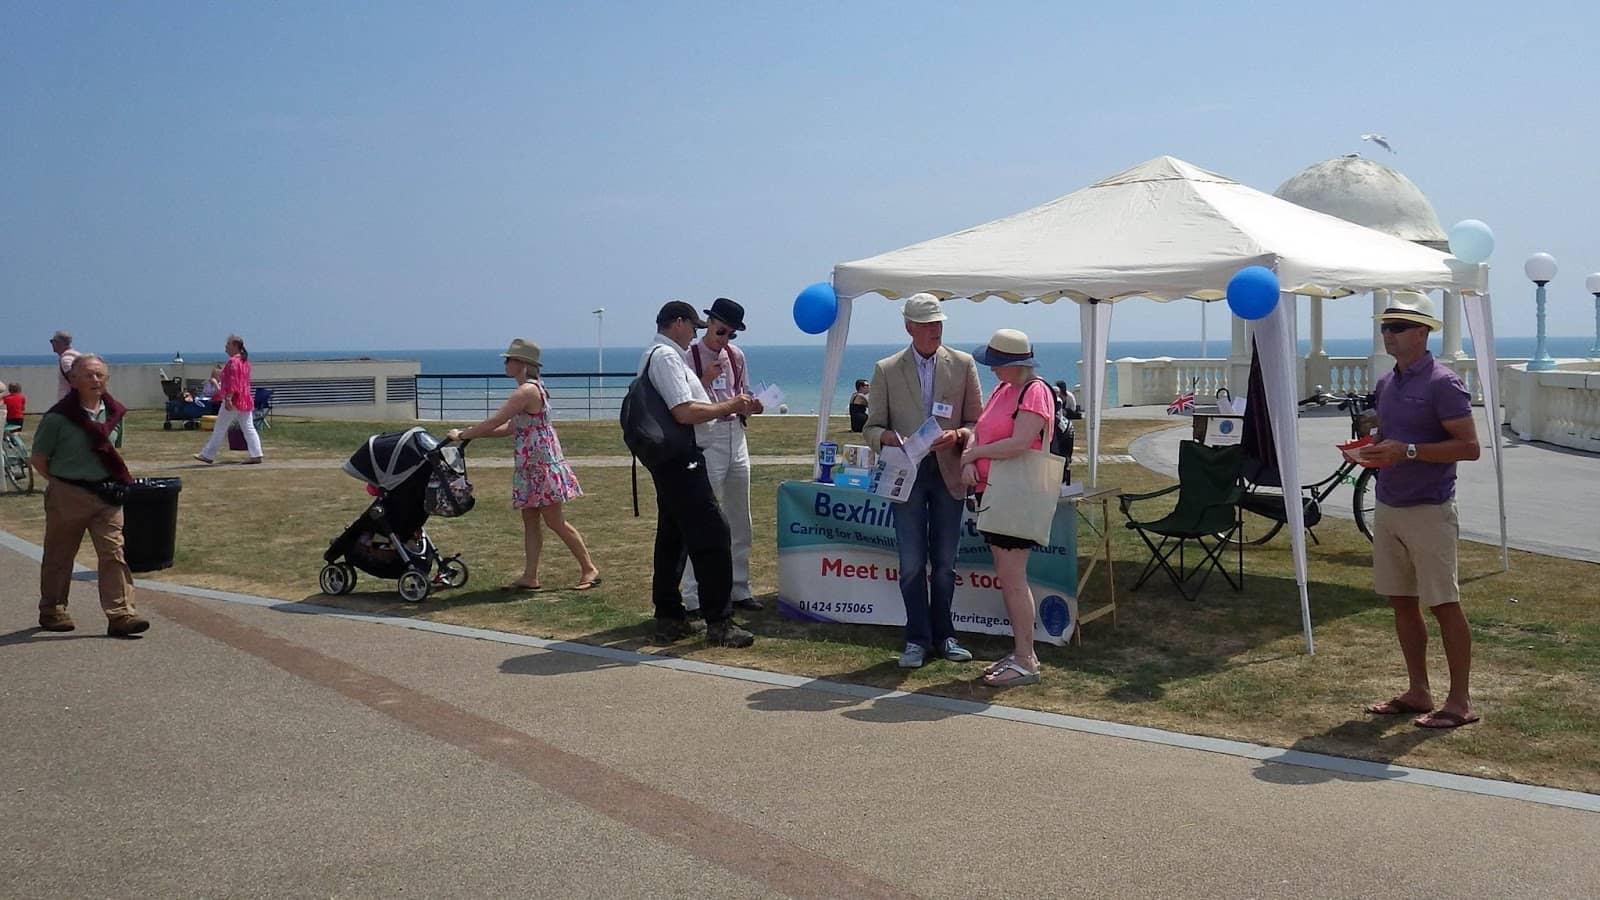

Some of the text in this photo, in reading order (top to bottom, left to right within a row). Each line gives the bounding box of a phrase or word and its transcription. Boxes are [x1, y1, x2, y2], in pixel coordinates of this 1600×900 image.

[790, 522, 833, 540] Caring
[835, 527, 852, 540] for
[1031, 543, 1067, 555] uture
[821, 557, 879, 580] Meet
[885, 567, 900, 581] u
[800, 600, 873, 614] 01424 575065
